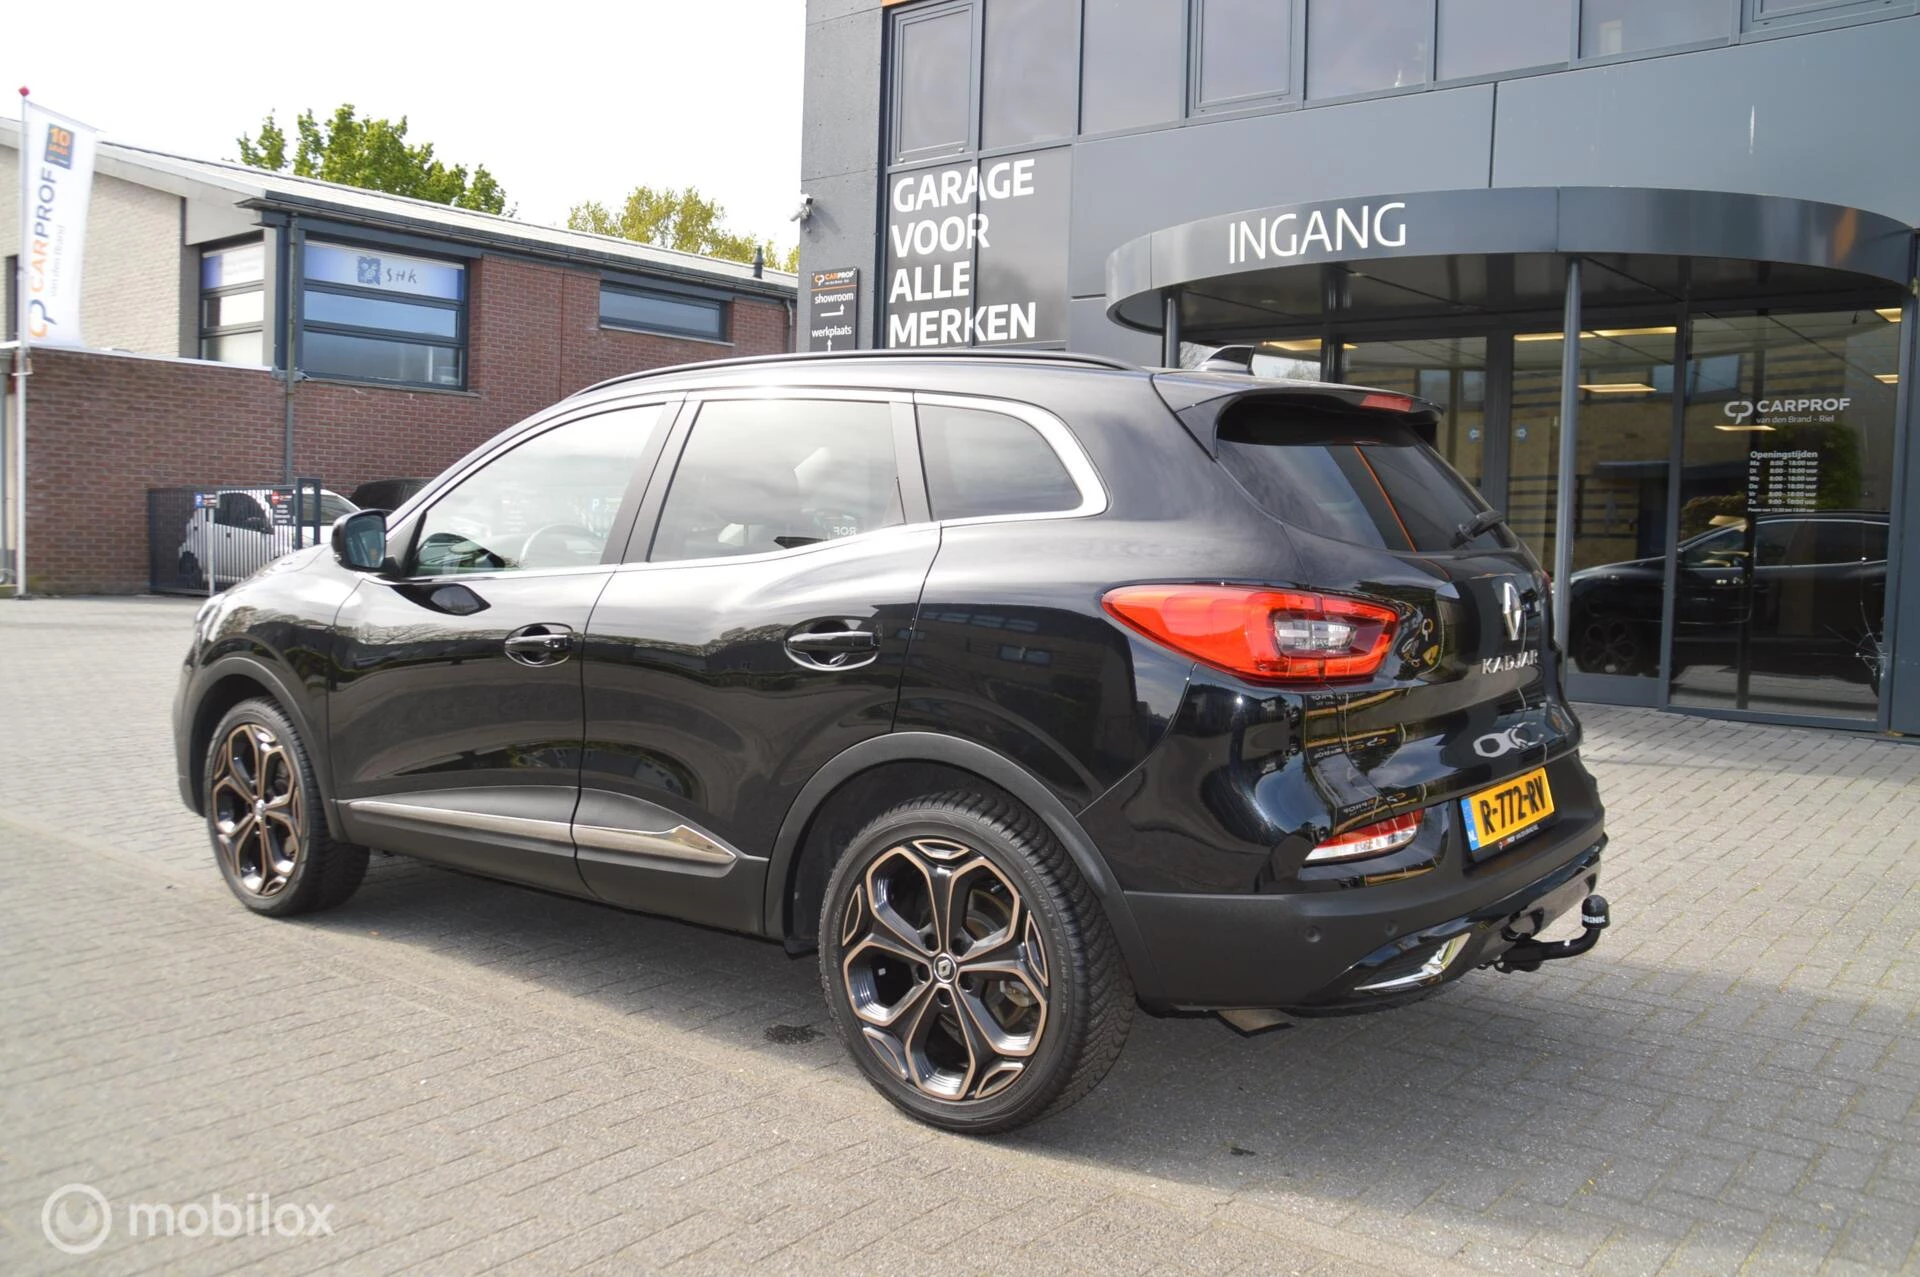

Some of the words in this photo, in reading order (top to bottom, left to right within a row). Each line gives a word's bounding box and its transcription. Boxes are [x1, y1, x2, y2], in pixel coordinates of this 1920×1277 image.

[893, 158, 1035, 212] GARAGE
[31, 167, 56, 293] CARPROF
[891, 213, 990, 258] VOOR
[1229, 202, 1406, 264] INGANG
[814, 292, 854, 304] showroom
[889, 260, 970, 304] ALLE
[811, 325, 852, 338] werkplaats
[889, 302, 1036, 348] MERKEN
[1757, 398, 1851, 412] CARPROF
[1772, 416, 1787, 424] den
[1788, 415, 1812, 423] Brand
[1820, 414, 1834, 422] Riel
[1750, 450, 1818, 459] Openingstijden
[1482, 649, 1538, 674] KADJAR
[1479, 776, 1546, 836] R-772-RV
